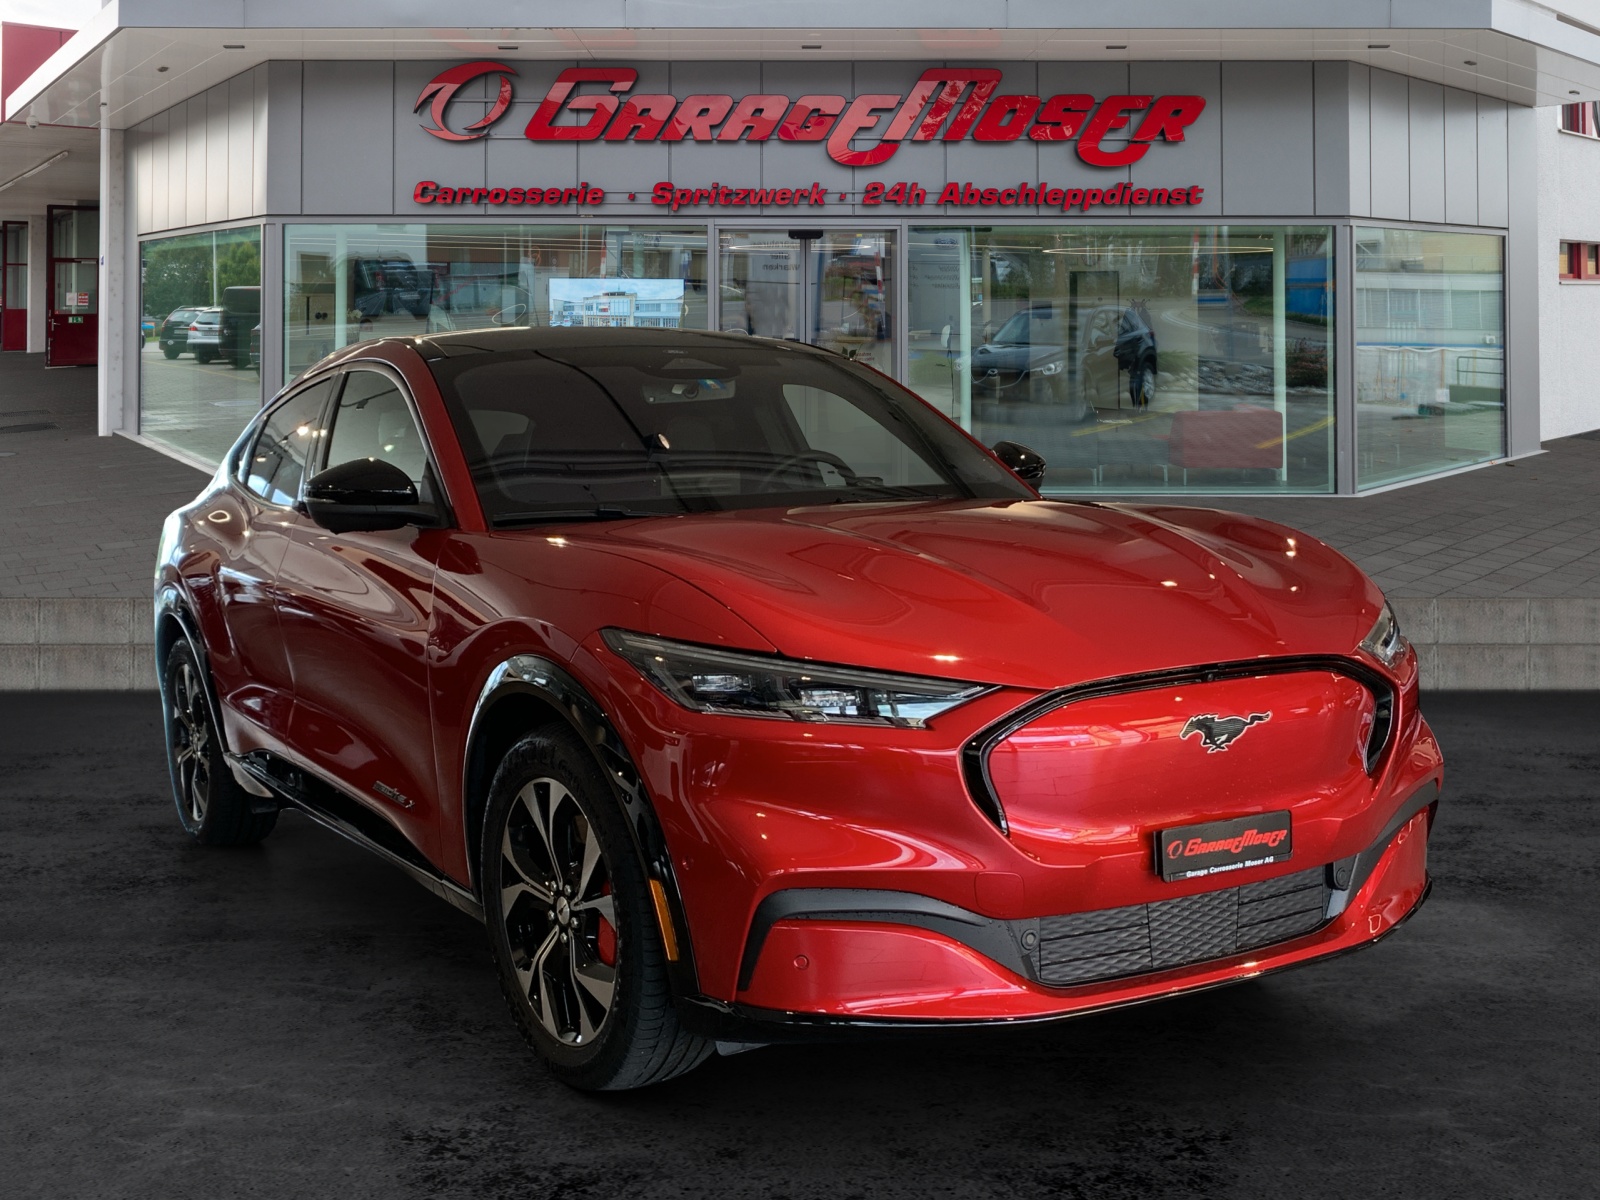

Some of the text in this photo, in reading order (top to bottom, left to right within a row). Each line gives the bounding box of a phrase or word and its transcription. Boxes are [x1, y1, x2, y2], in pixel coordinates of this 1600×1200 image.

[413, 181, 1204, 212] Carrosserie Spritzwerk 24h Abschleppdienst
[1186, 868, 1208, 878] Garage
[1244, 858, 1264, 867] Moser
[1264, 855, 1274, 863] AG
